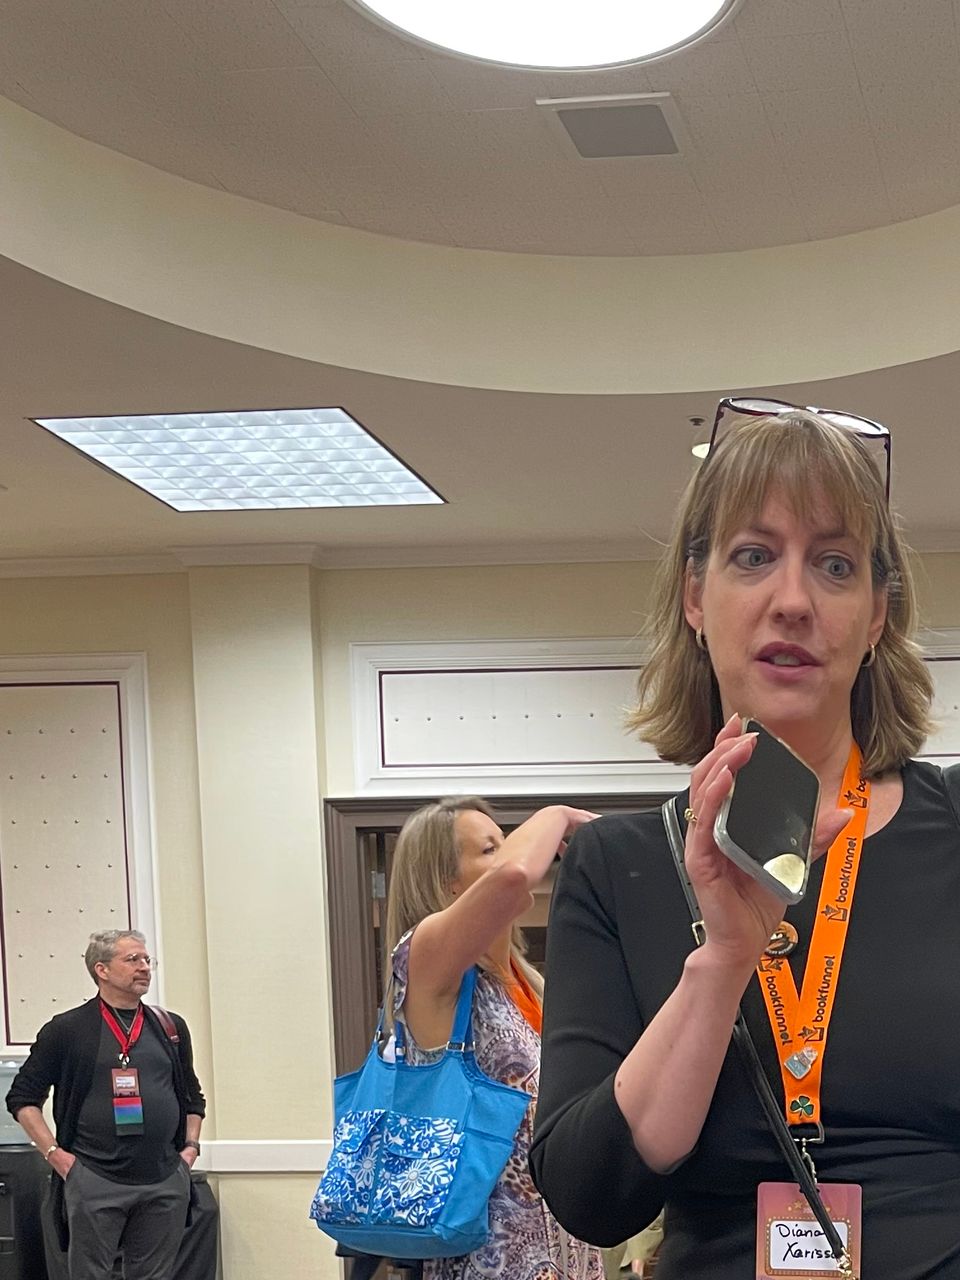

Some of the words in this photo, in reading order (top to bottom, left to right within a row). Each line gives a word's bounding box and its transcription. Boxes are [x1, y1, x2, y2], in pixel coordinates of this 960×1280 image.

[836, 837, 857, 903] bookfunnel
[765, 976, 793, 1046] bookfunnel
[812, 955, 835, 1023] bookfunnel
[776, 1223, 826, 1237] Diana
